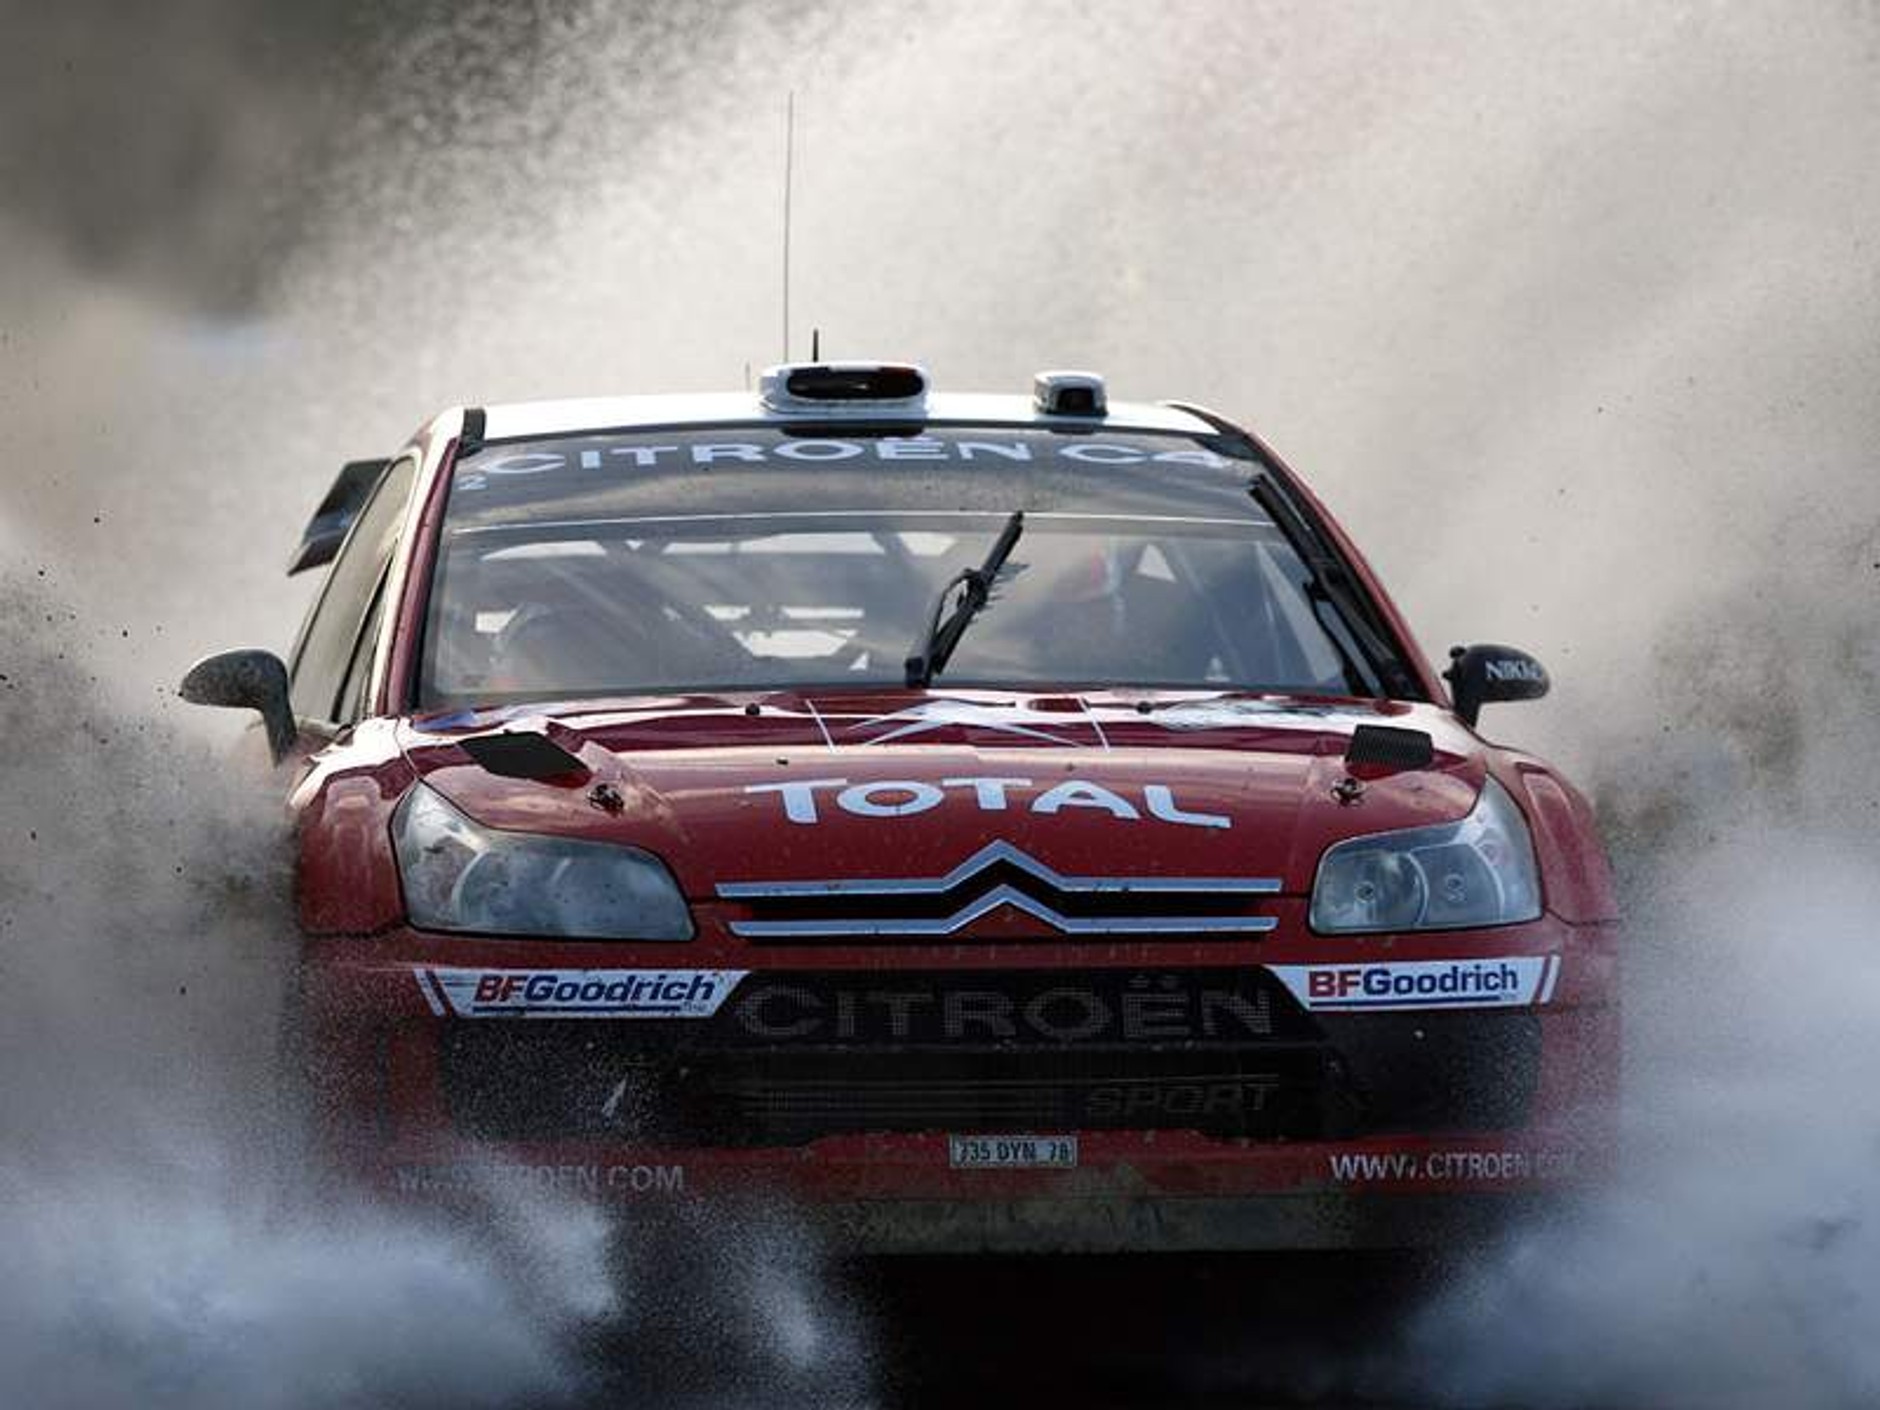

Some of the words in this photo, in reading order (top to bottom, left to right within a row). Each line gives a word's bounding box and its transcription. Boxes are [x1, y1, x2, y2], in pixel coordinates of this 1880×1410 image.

[1059, 443, 1224, 469] C4
[744, 778, 1231, 829] TOTAL
[473, 974, 717, 1002] BFGoodrich
[1308, 963, 1518, 998] BFGoodrich
[737, 973, 1273, 1038] CITROËN
[1088, 1081, 1276, 1114] SPORT
[996, 1141, 1037, 1160] DYN
